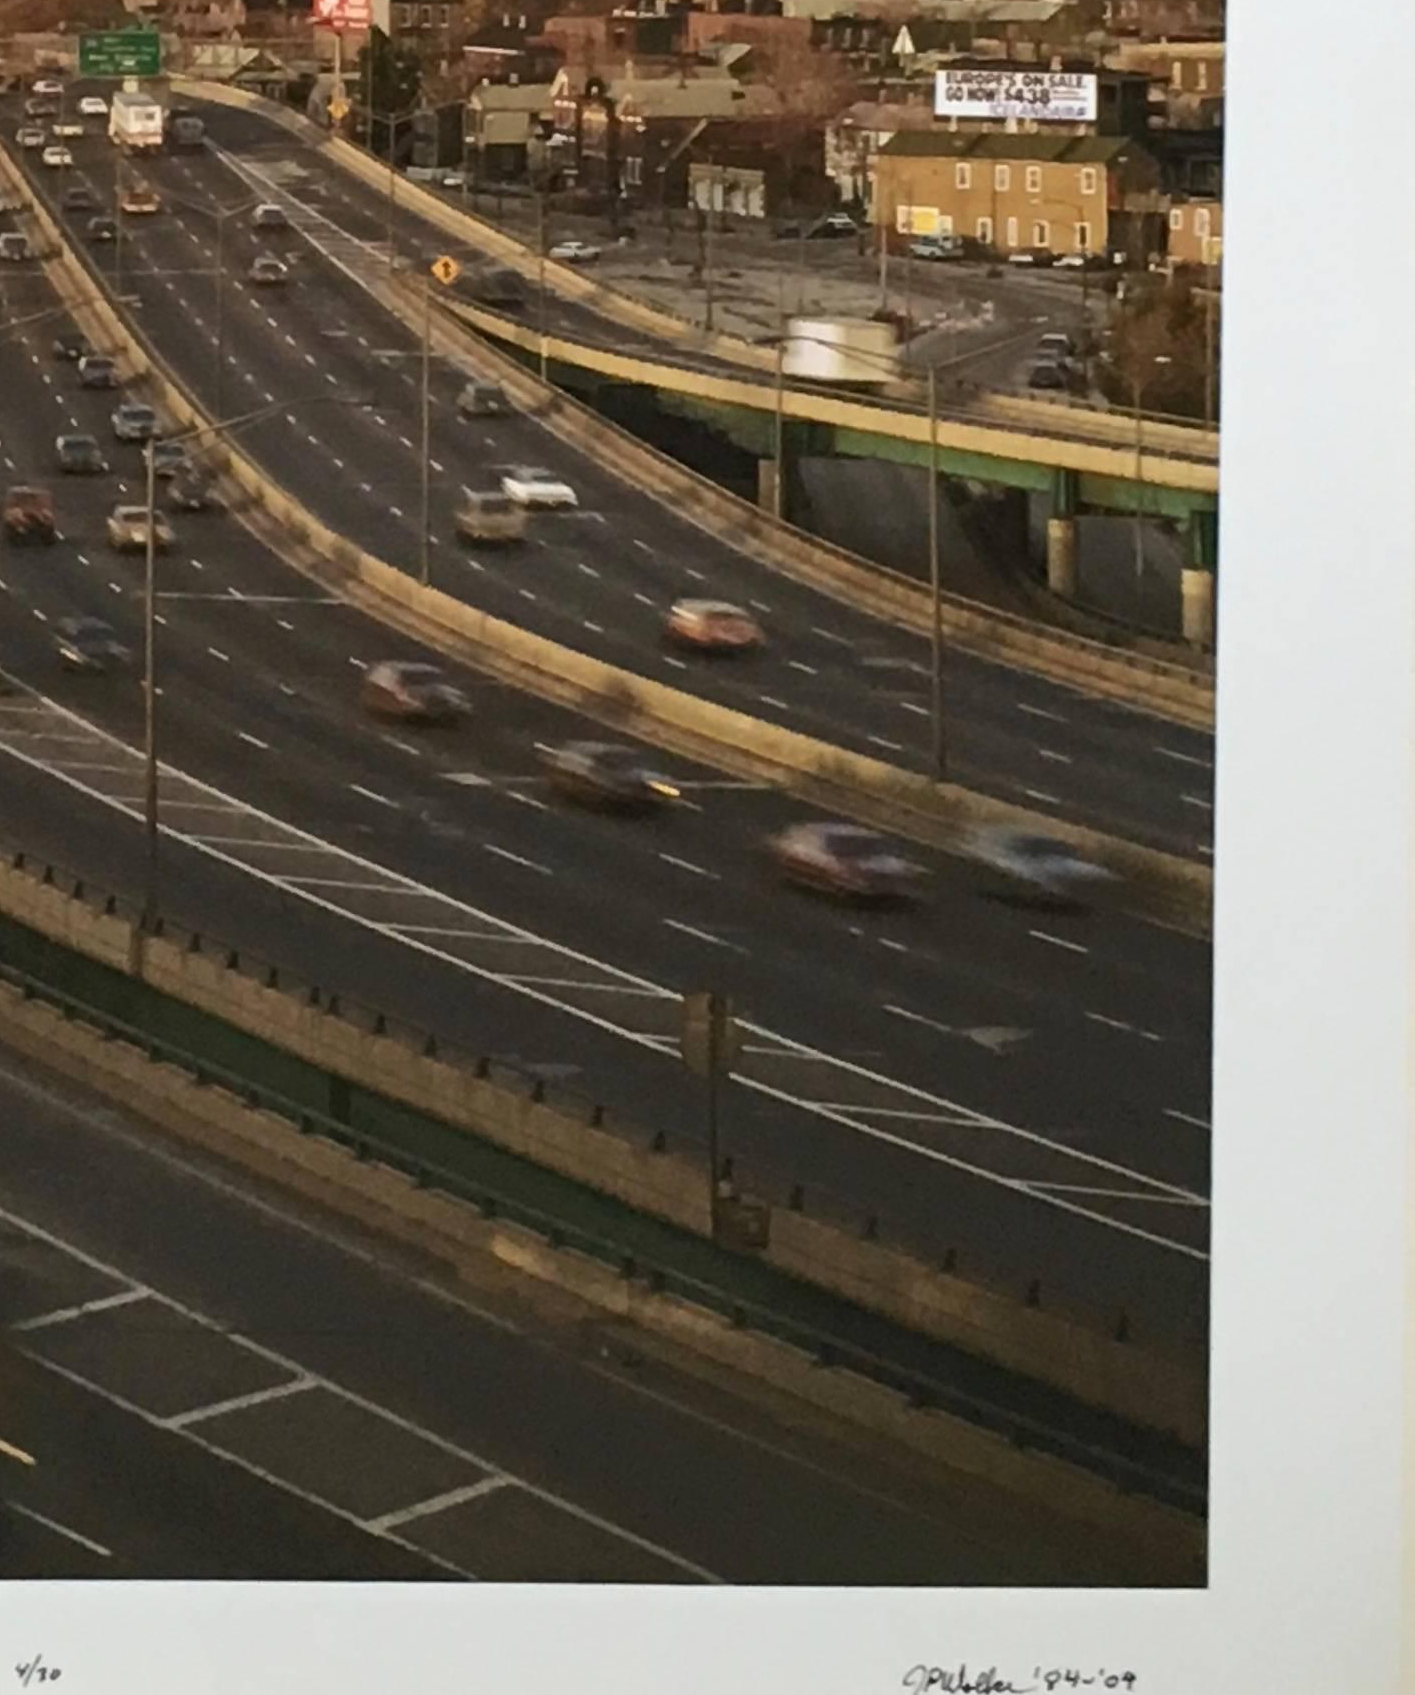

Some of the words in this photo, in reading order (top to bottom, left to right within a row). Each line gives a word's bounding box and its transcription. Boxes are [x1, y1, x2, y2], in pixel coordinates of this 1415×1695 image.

[946, 72, 1016, 87] EUROPE'S
[1022, 74, 1044, 87] ON
[946, 86, 963, 102] GO
